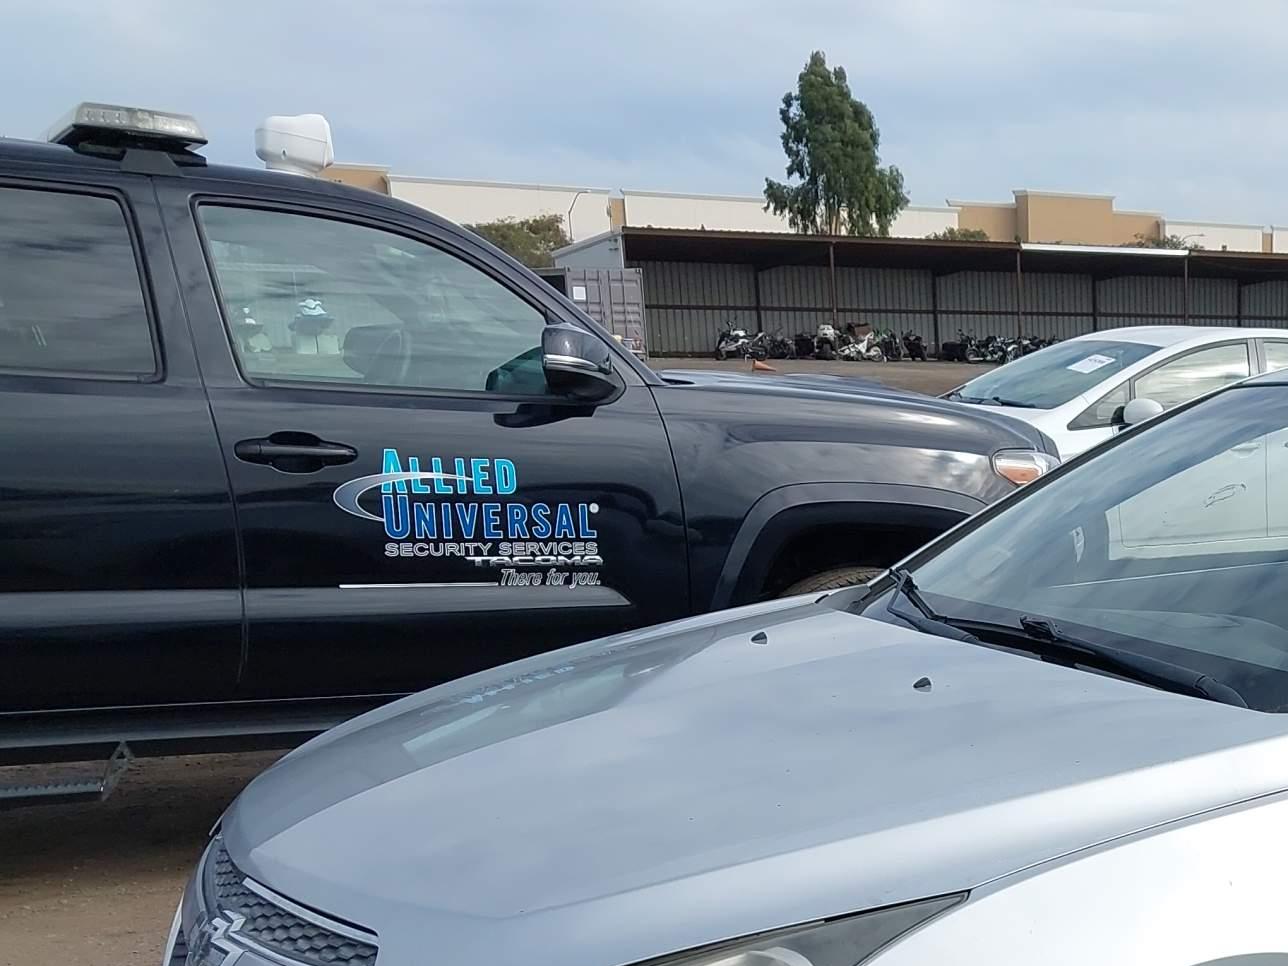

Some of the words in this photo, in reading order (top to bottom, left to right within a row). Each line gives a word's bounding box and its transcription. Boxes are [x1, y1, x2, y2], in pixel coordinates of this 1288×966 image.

[381, 448, 516, 495] ALLIED
[384, 542, 493, 557] SECURITY
[498, 541, 599, 556] SERVICES
[464, 556, 604, 567] TACOMA
[500, 568, 542, 586] There
[545, 568, 569, 586] for
[568, 572, 602, 589] you.
